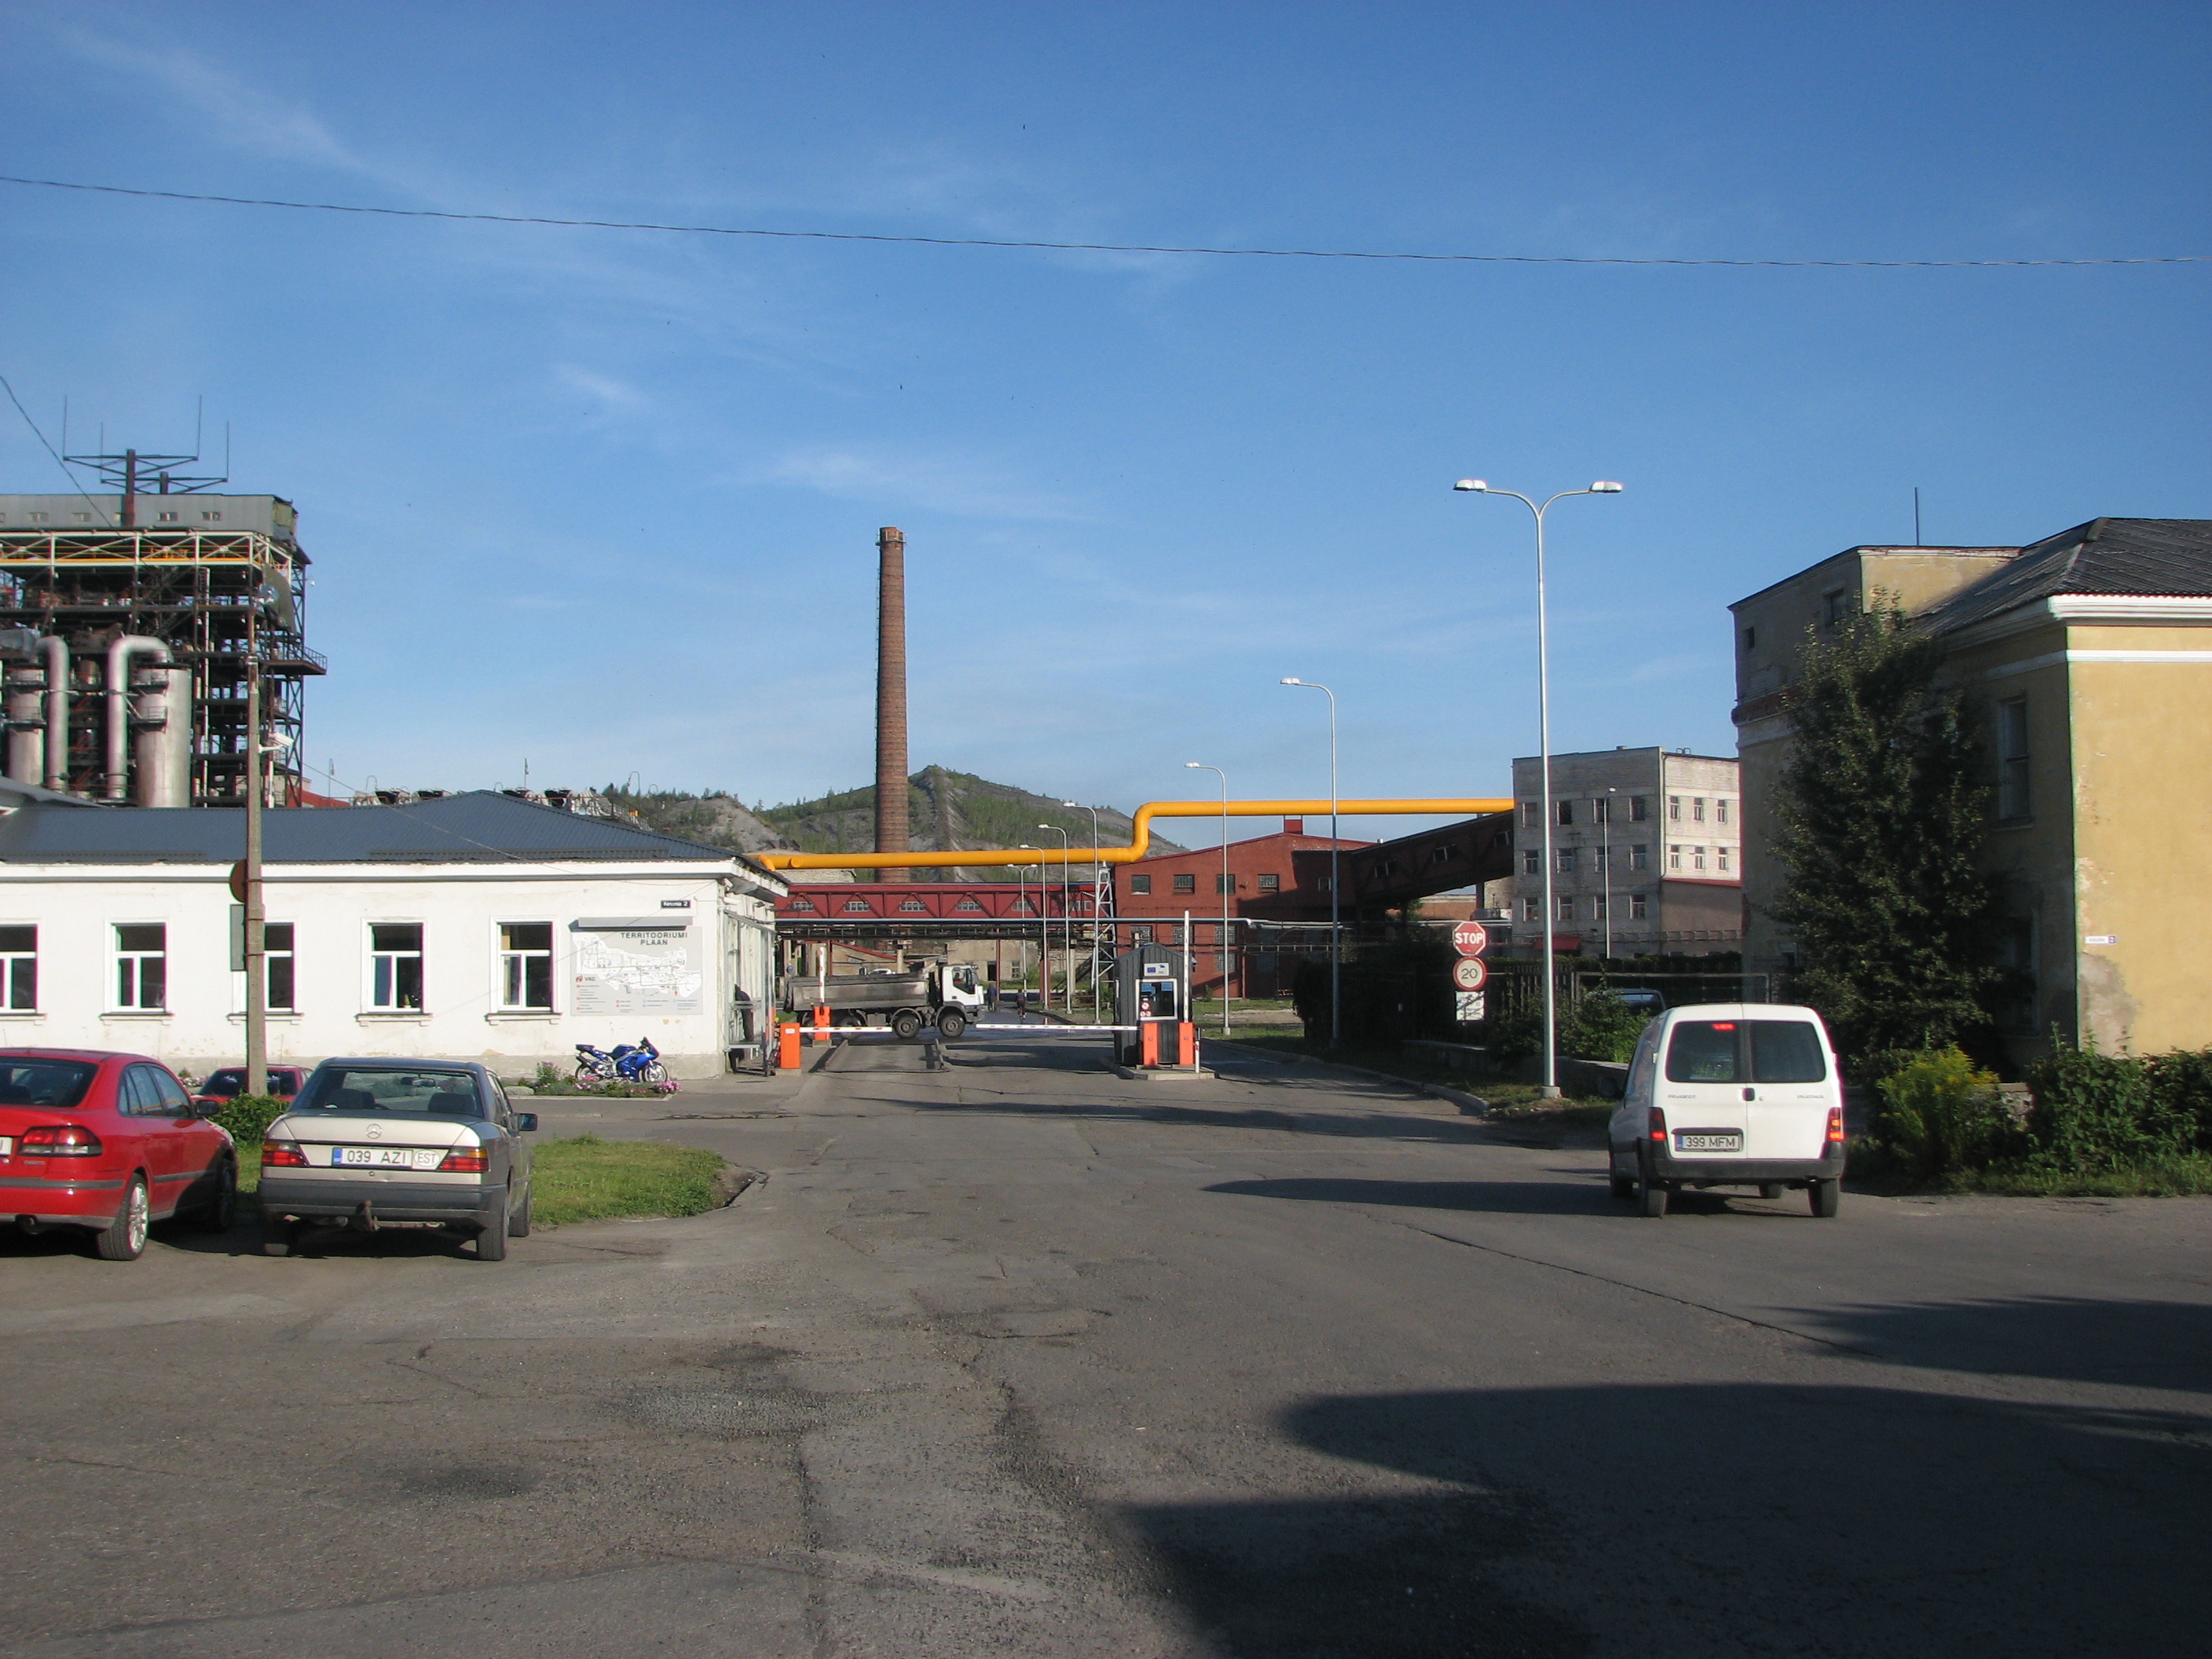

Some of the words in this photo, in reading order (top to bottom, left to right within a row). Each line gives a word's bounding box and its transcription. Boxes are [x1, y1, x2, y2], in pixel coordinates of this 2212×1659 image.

[1455, 932, 1484, 944] STOP
[1461, 968, 1478, 980] 20
[1686, 1137, 1705, 1147] 399
[1708, 1137, 1735, 1147] MFM
[347, 1150, 371, 1163] 039
[380, 1151, 406, 1164] AZI
[417, 1152, 437, 1164] EST
